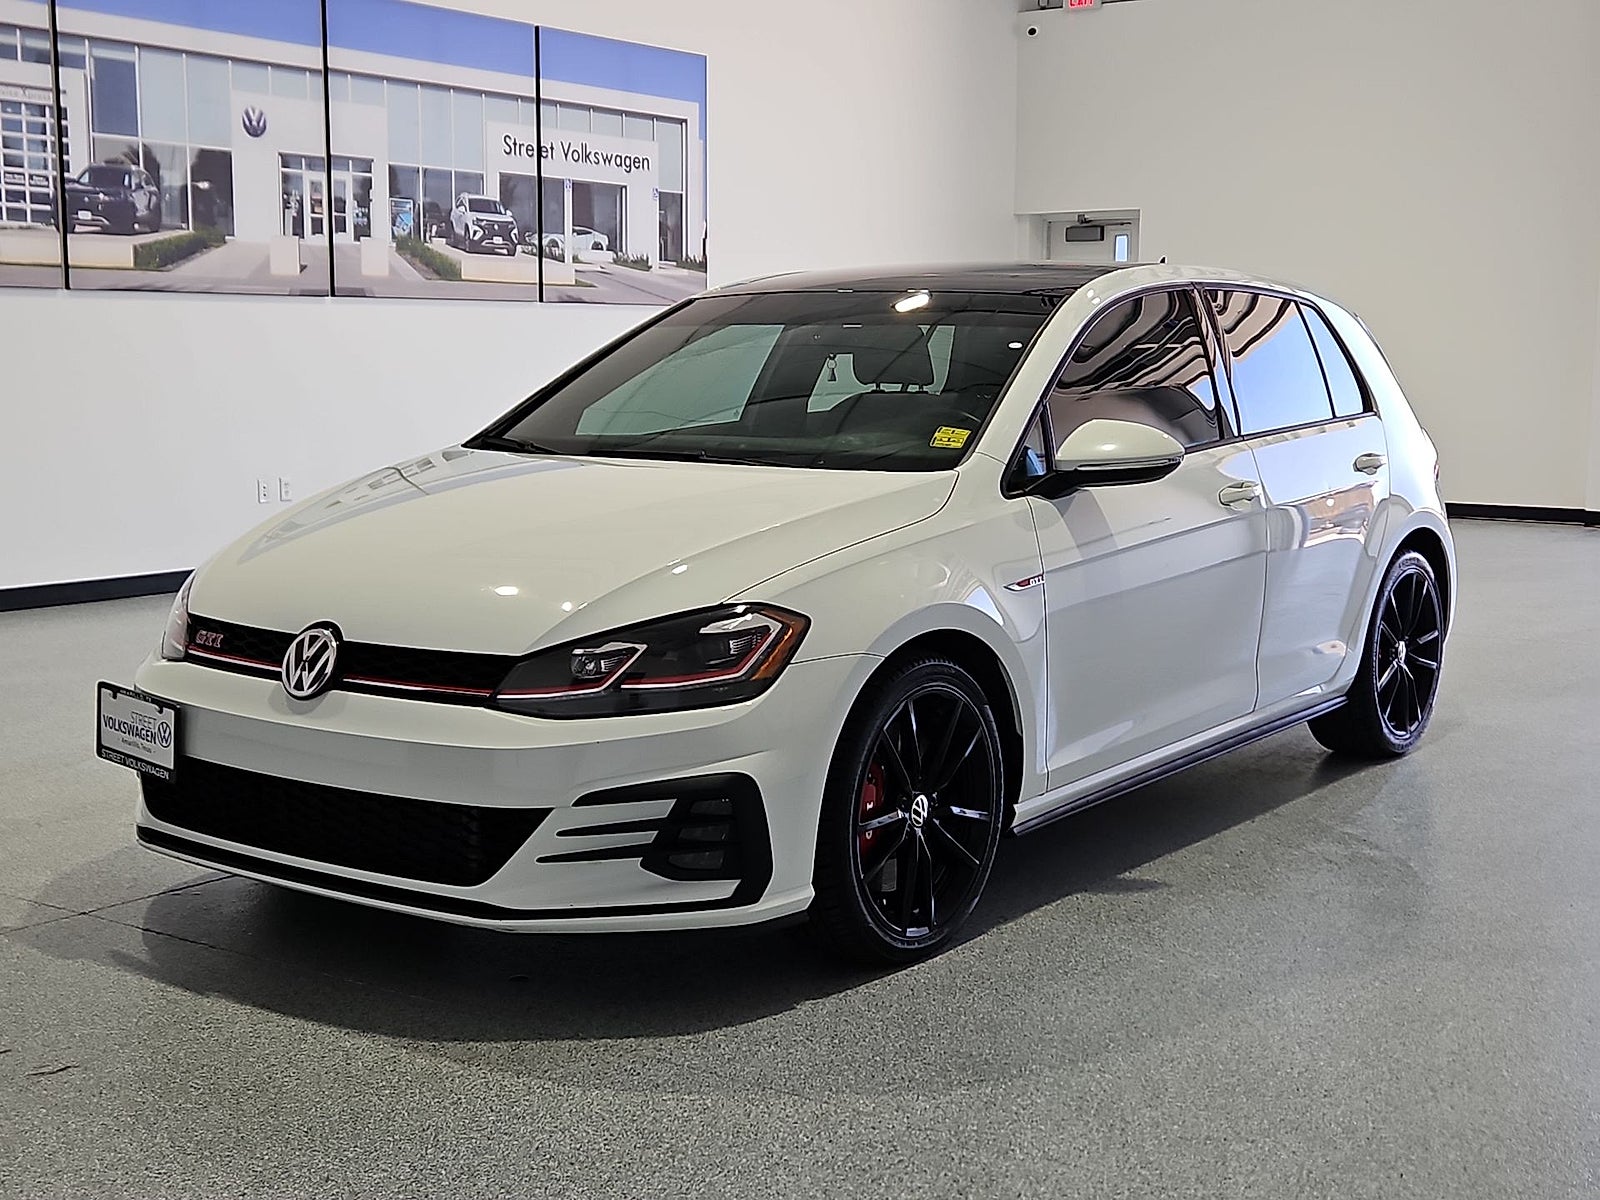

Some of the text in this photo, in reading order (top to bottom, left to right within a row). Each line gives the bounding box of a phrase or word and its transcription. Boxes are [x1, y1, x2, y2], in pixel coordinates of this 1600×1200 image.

[503, 134, 650, 173] Street Volkswagen
[195, 629, 224, 648] GTI
[102, 713, 157, 745] VOLKSWAGEN
[131, 711, 157, 730] STREET
[101, 748, 169, 780] STREET VOLKSWAGEN
